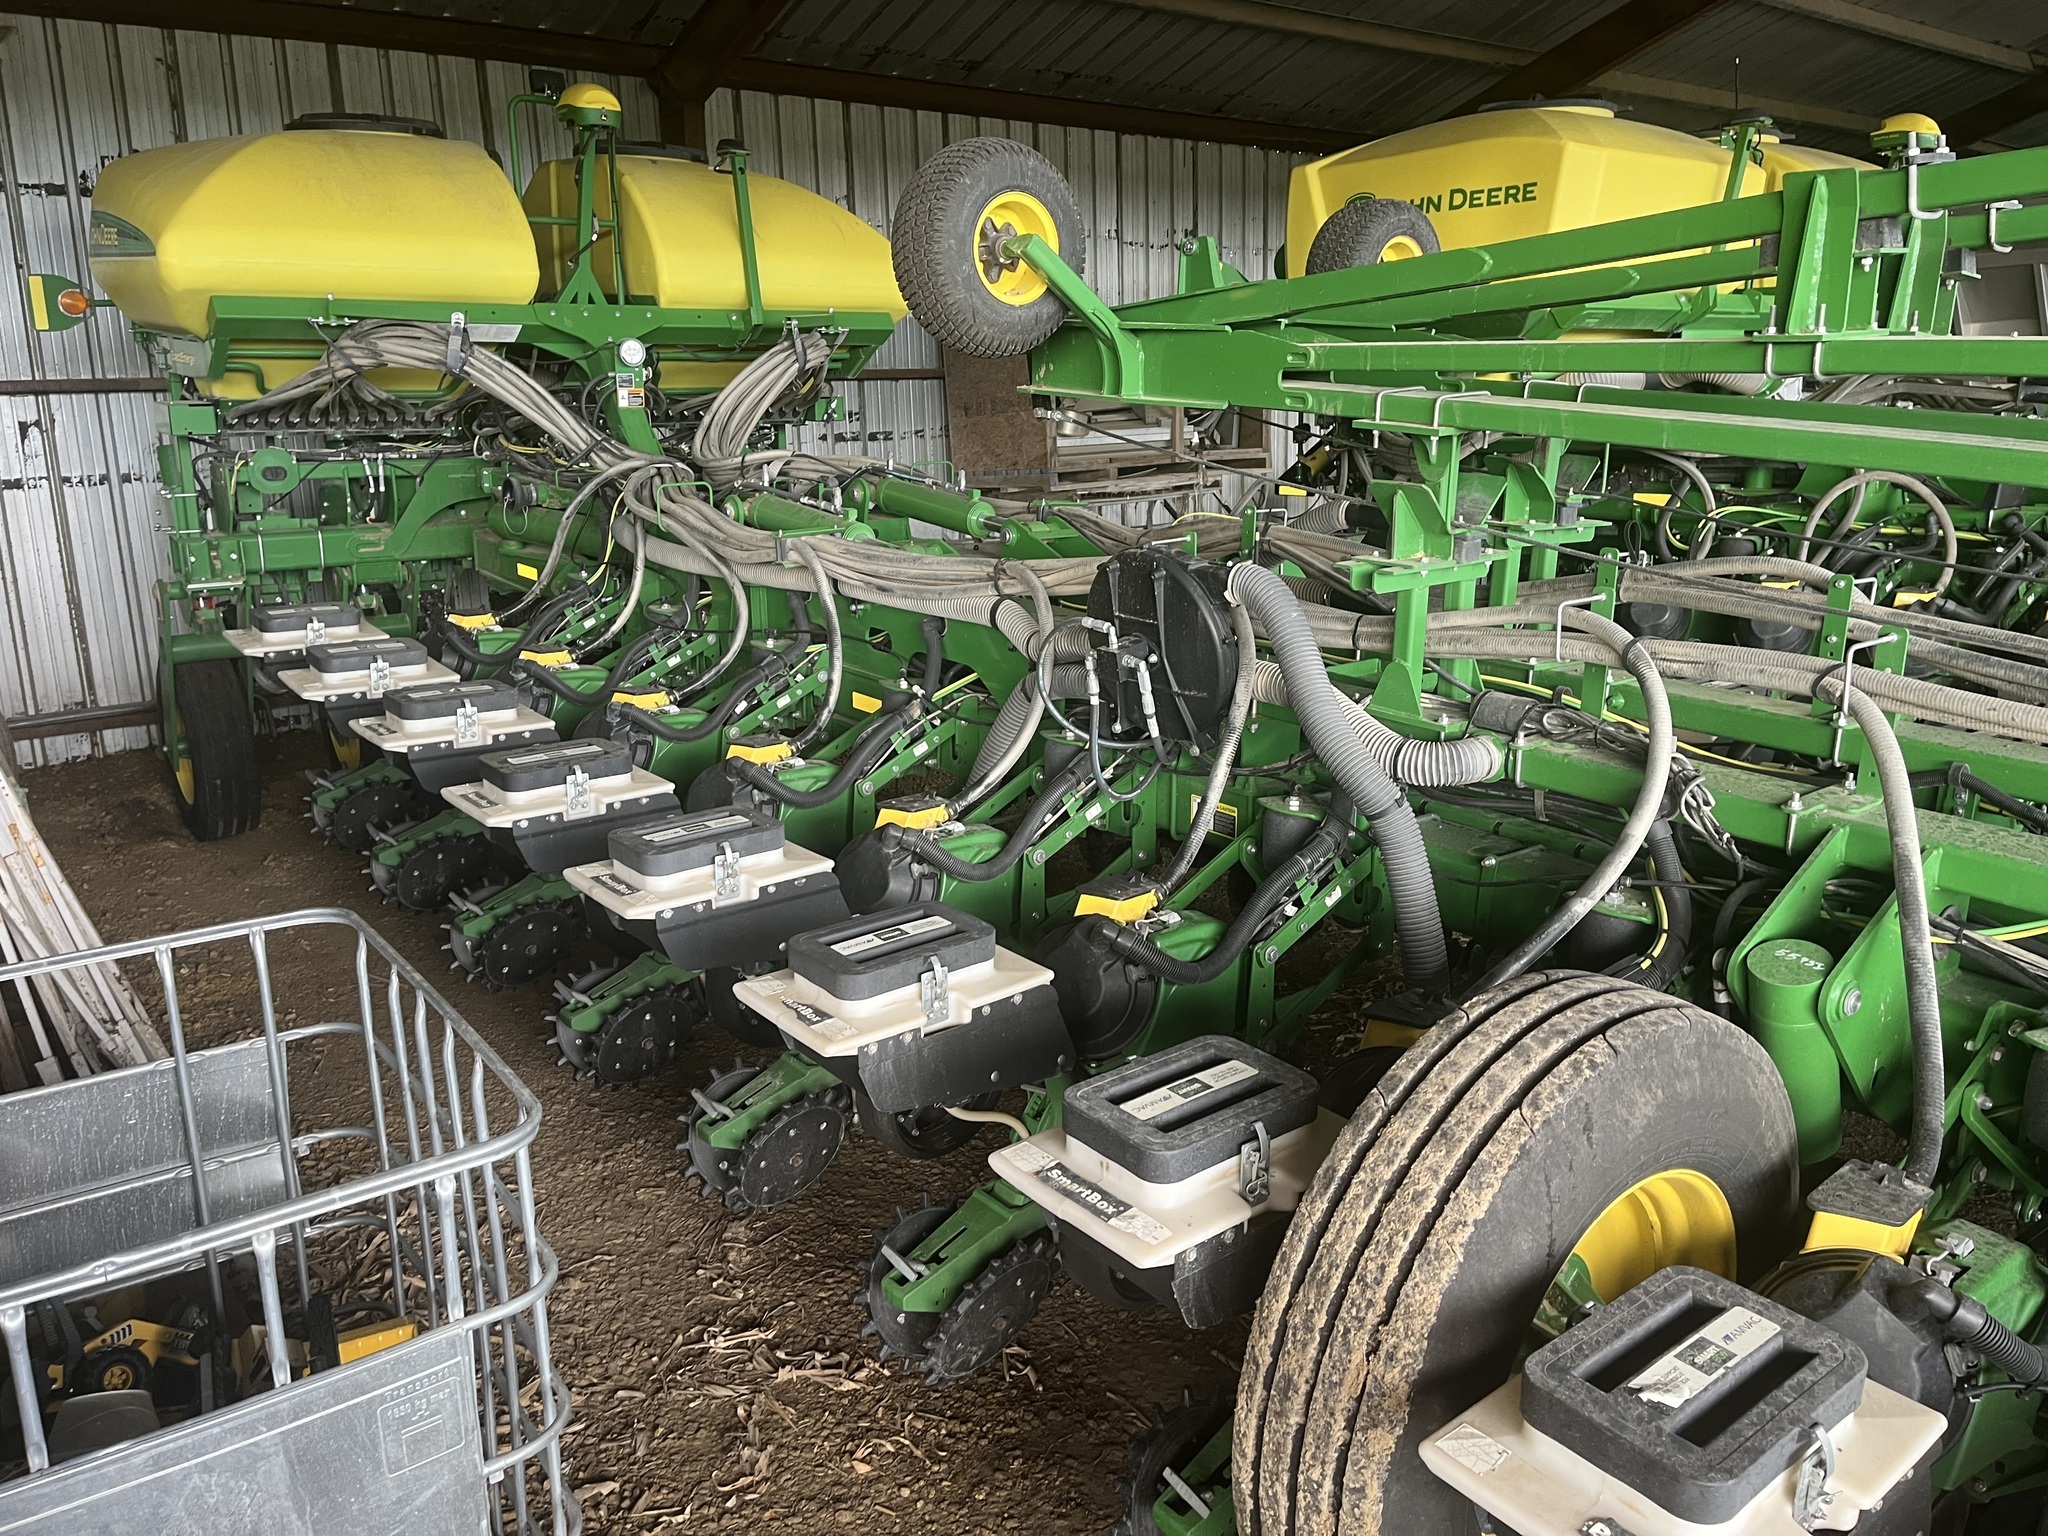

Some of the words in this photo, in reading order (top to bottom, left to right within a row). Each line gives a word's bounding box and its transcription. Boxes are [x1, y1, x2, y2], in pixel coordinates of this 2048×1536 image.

[1448, 181, 1538, 211] DEERE
[779, 995, 822, 1022] martBox
[1047, 1168, 1118, 1215] SmartBox
[1730, 1315, 1762, 1340] AMVAC
[1694, 1344, 1721, 1365] SMART
[384, 1367, 450, 1401] Transport
